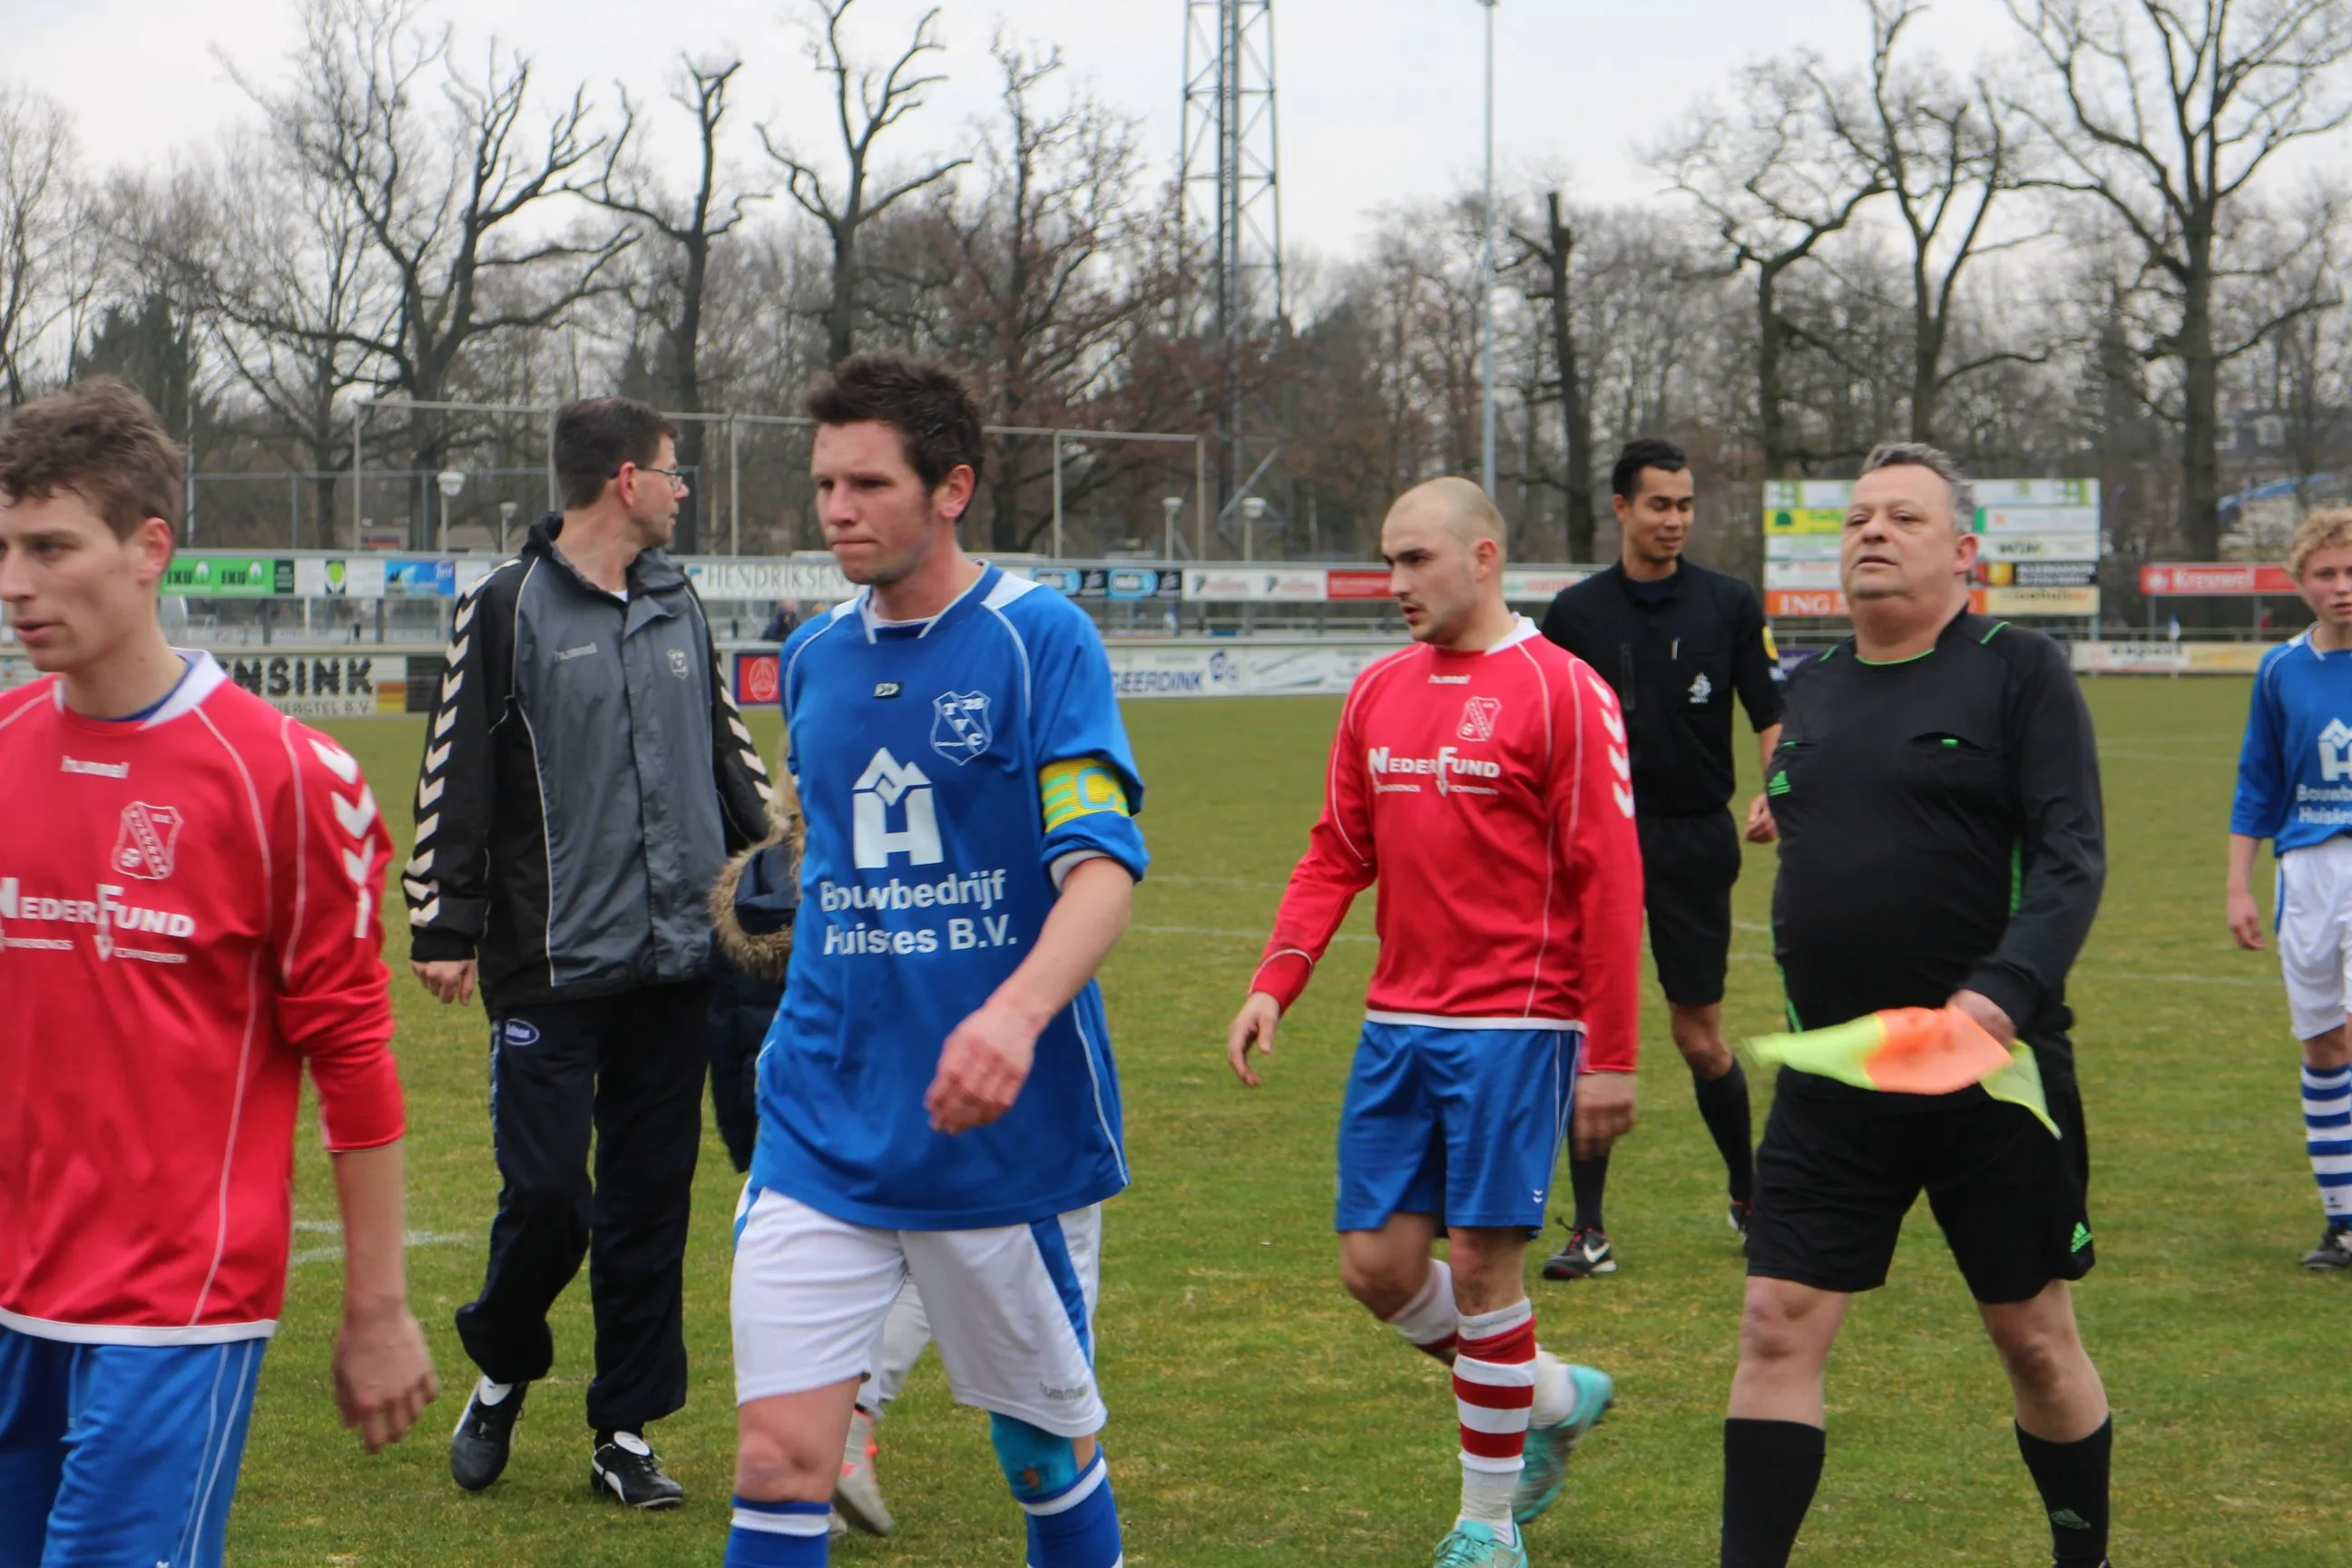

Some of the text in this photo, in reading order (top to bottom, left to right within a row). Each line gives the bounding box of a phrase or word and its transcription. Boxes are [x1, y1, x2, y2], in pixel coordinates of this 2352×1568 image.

[1779, 593, 1830, 616] ING
[820, 868, 1007, 912] Bouwbedrijf
[948, 914, 1017, 951] B.V.
